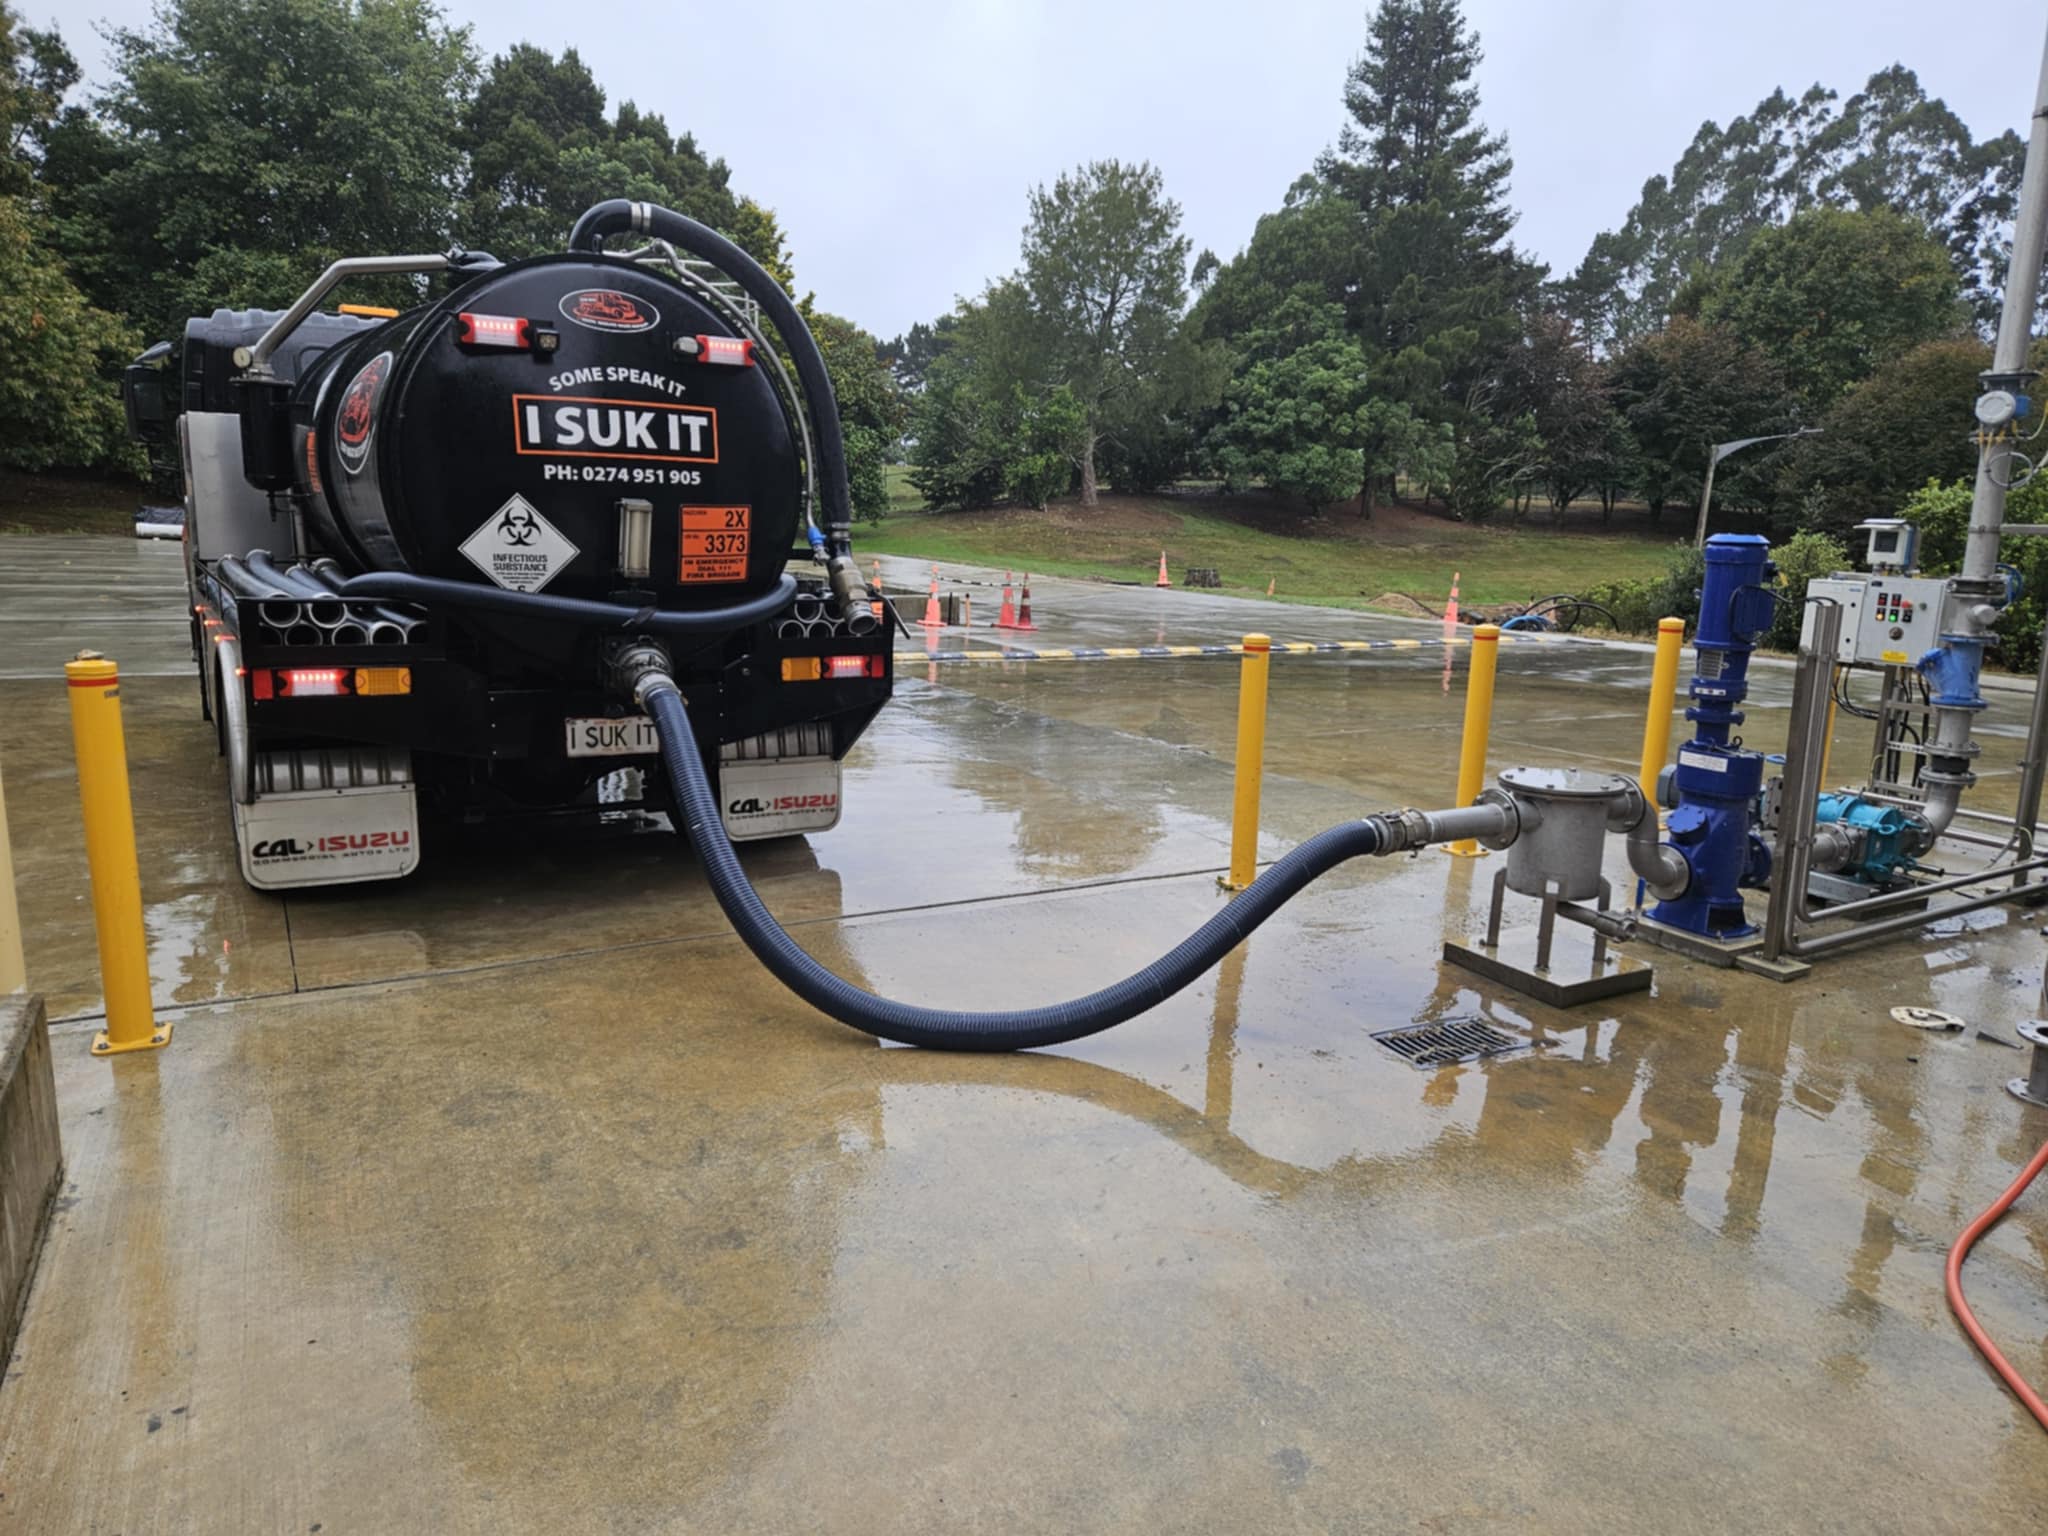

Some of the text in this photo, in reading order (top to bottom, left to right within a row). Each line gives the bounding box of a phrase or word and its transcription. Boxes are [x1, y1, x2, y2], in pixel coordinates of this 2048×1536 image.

[549, 366, 686, 397] SOME SPEAK IT
[525, 405, 708, 452] I SUK IT
[543, 464, 701, 485] PH: 0274 951 905
[724, 510, 745, 528] 2X
[704, 534, 746, 553] 3373
[492, 553, 548, 563] INFECTIOUS
[493, 562, 548, 572] SUBSTANCE
[571, 723, 656, 749] I SUK IT
[729, 794, 836, 814] CAL ISUZU
[252, 831, 409, 858] CAL ISUZU
